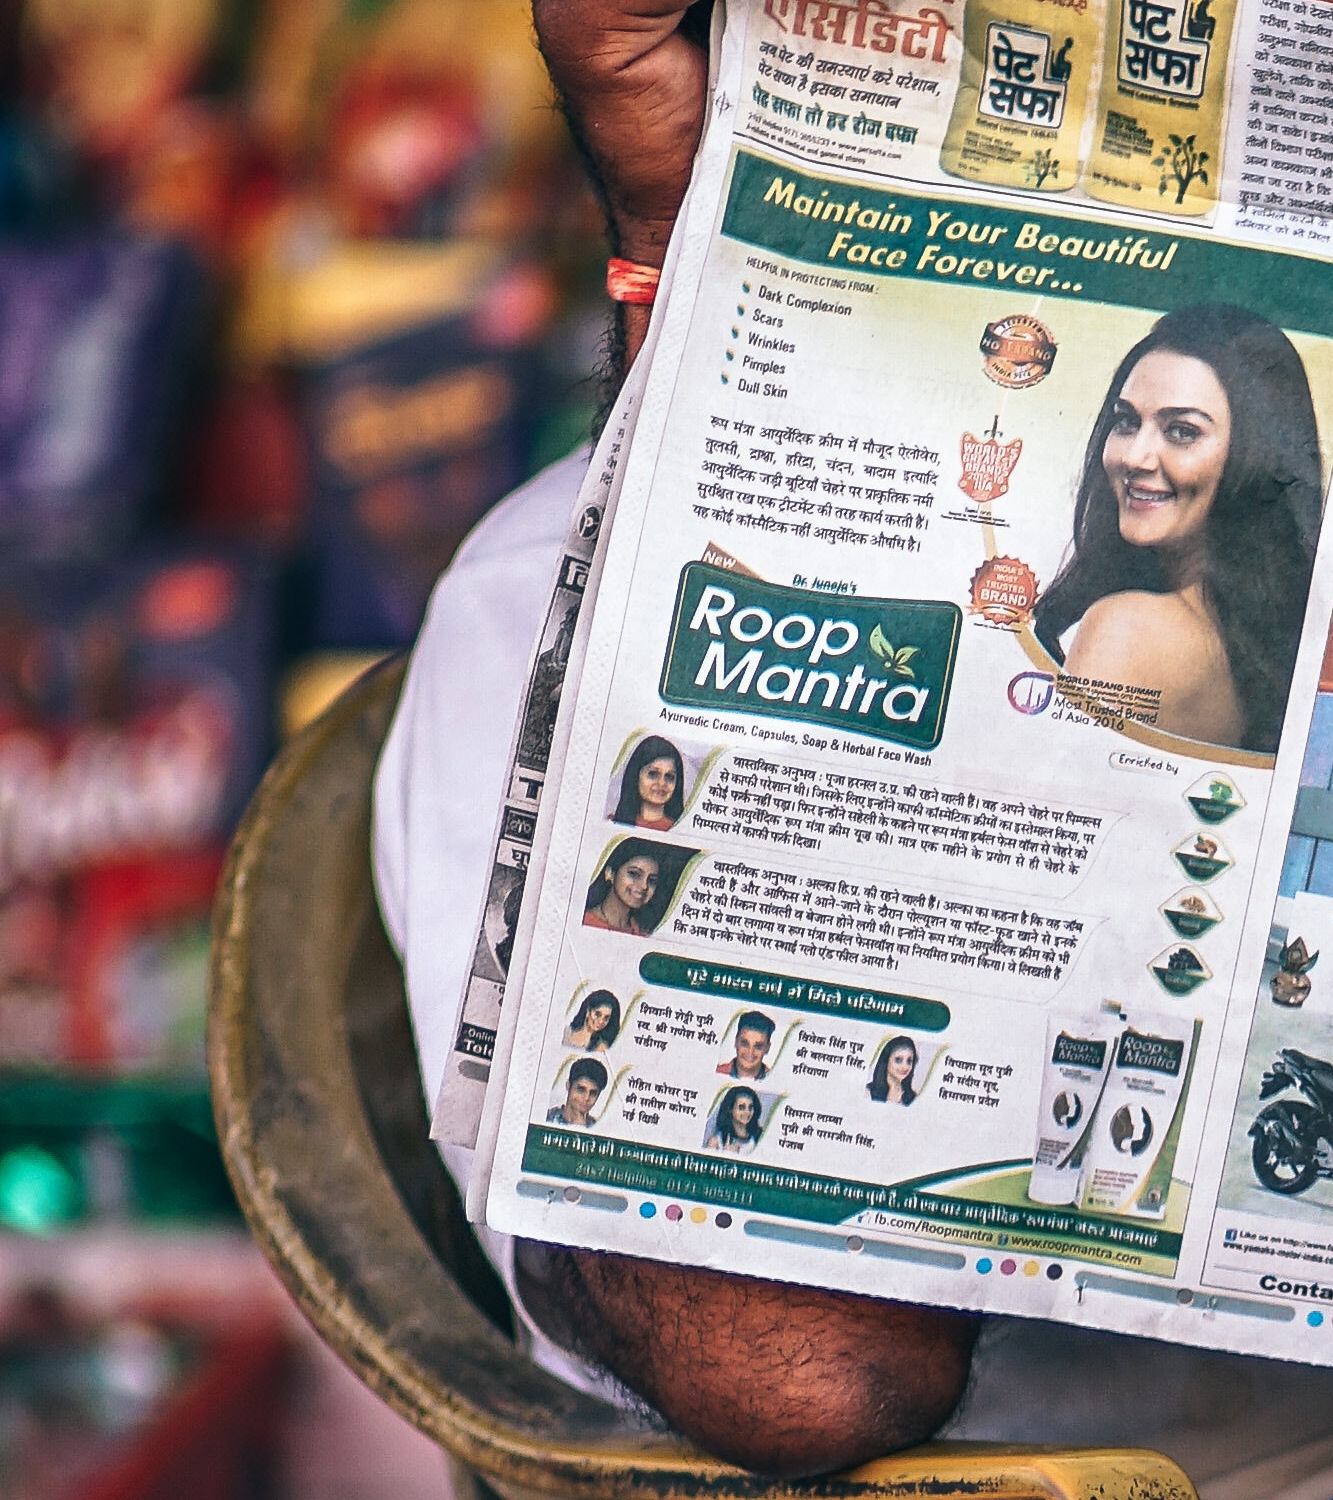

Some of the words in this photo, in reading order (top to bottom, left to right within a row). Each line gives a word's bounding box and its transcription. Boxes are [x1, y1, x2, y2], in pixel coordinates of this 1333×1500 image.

[1126, 39, 1201, 90] सफा
[763, 177, 912, 234] Maintain
[926, 210, 1009, 244] Your
[1013, 222, 1178, 270] Beautiful
[828, 232, 907, 268] Face
[915, 244, 1083, 292] Forever...
[753, 308, 783, 328] Scars
[758, 284, 783, 304] Dark
[786, 293, 852, 316] Complexion
[748, 332, 796, 353] Wrinkles
[743, 355, 785, 375] Pimples
[737, 378, 761, 395] Dull
[762, 383, 788, 399] Skin
[703, 551, 737, 568] New
[689, 585, 859, 664] Roop
[694, 641, 929, 722] Mantra
[659, 707, 710, 728] Ayurvedic
[712, 717, 747, 736] Cream,
[751, 725, 799, 746] Capsules,
[801, 733, 828, 752] Soap
[830, 738, 840, 751] &
[842, 740, 876, 758] Herbal
[877, 746, 901, 762] Face
[904, 751, 932, 767] Wash
